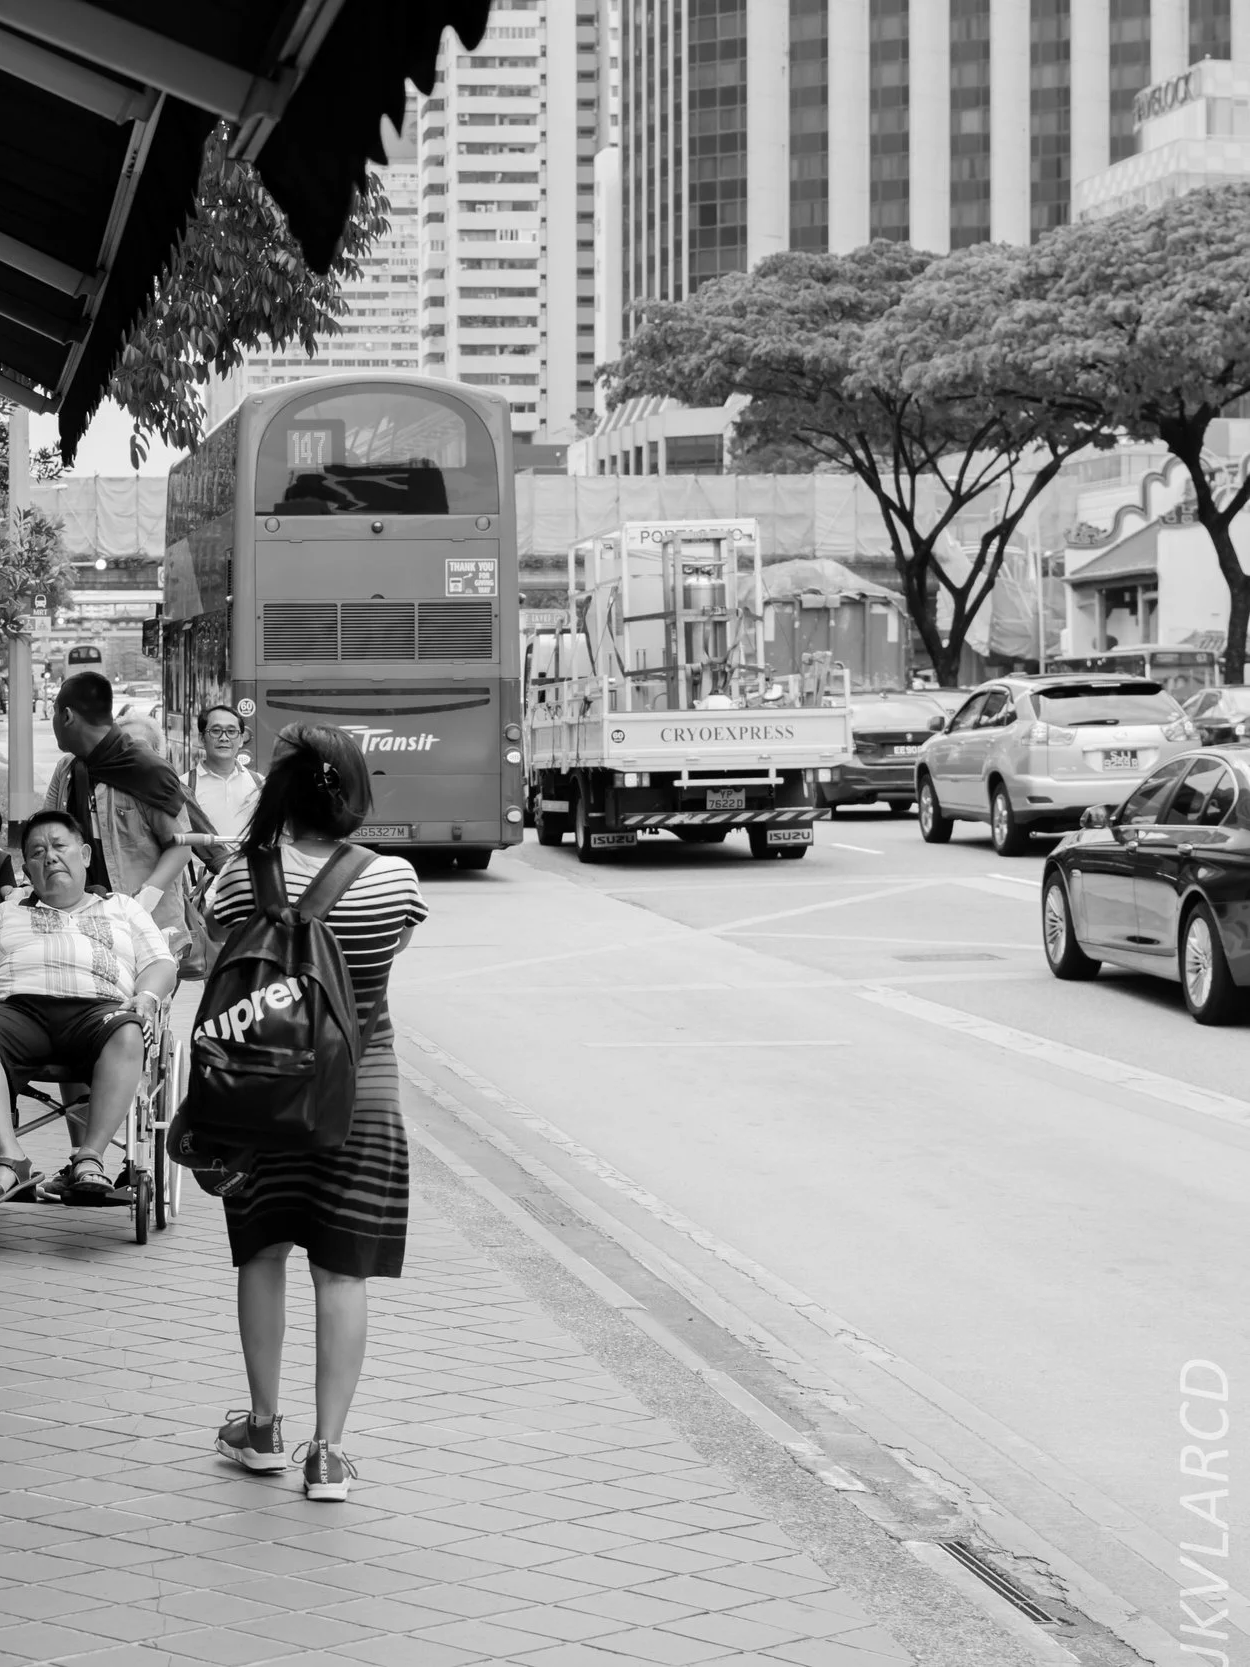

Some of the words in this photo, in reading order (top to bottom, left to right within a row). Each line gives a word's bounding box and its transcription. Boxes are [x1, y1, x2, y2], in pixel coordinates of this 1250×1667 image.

[292, 431, 326, 464] 147
[449, 561, 476, 572] THANK
[477, 561, 494, 571] YOU
[33, 608, 48, 616] MRT
[240, 701, 253, 710] 60
[660, 725, 795, 743] CRYOEXPRESS
[351, 729, 441, 755] Transit
[720, 790, 733, 799] YP
[709, 800, 743, 809] 7622D
[354, 827, 405, 838] SG5327M
[769, 831, 811, 841] ISUZU
[592, 834, 635, 845] ISUZU
